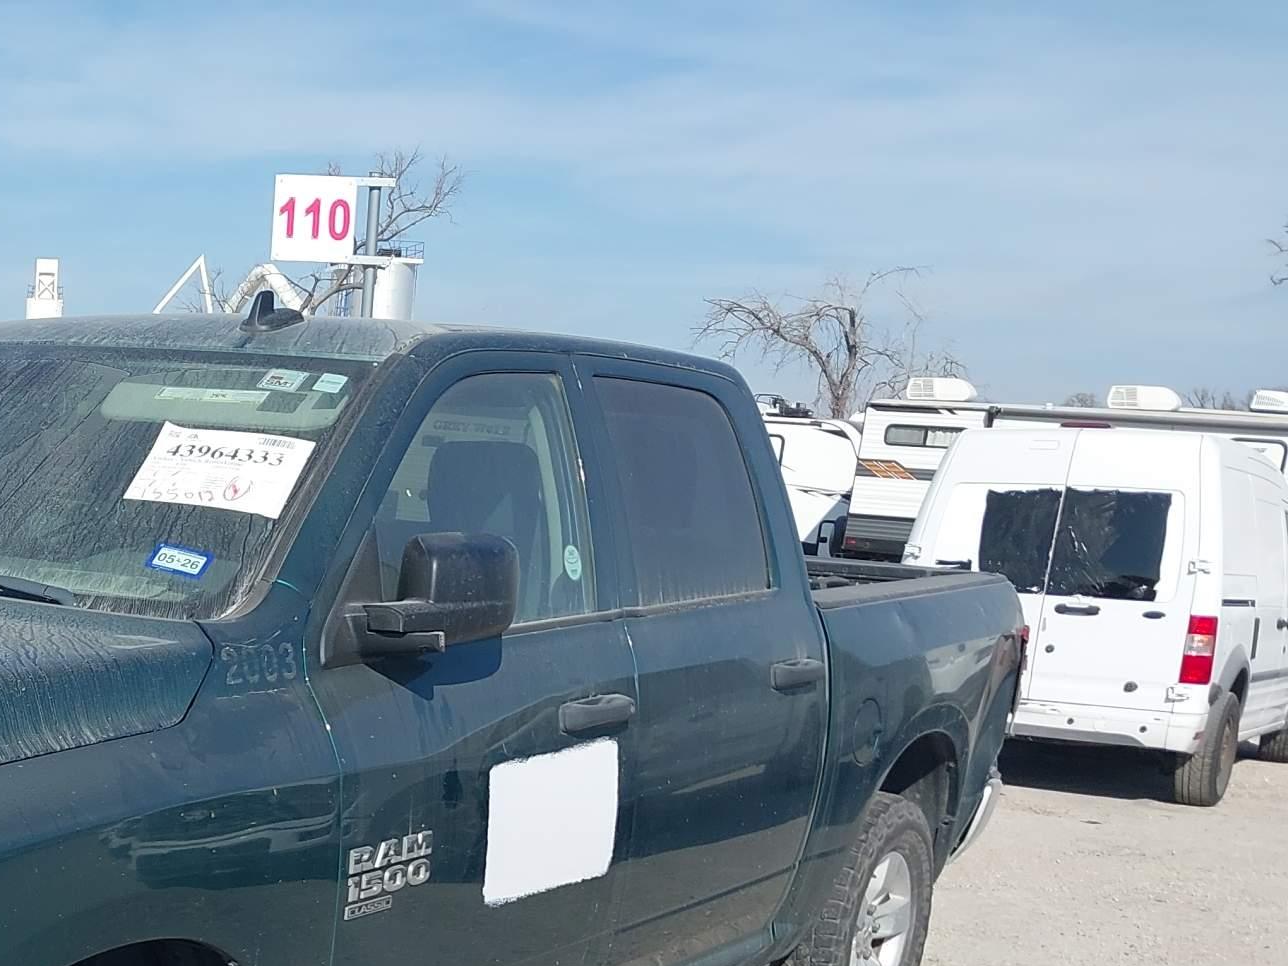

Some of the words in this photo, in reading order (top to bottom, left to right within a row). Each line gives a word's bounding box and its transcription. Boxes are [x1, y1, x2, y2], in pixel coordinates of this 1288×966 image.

[278, 195, 351, 241] 110
[166, 442, 286, 467] 43964333
[220, 641, 298, 685] 2003
[348, 829, 433, 875] RAM
[347, 857, 431, 903] 1500
[347, 896, 392, 919] CLASSIC
